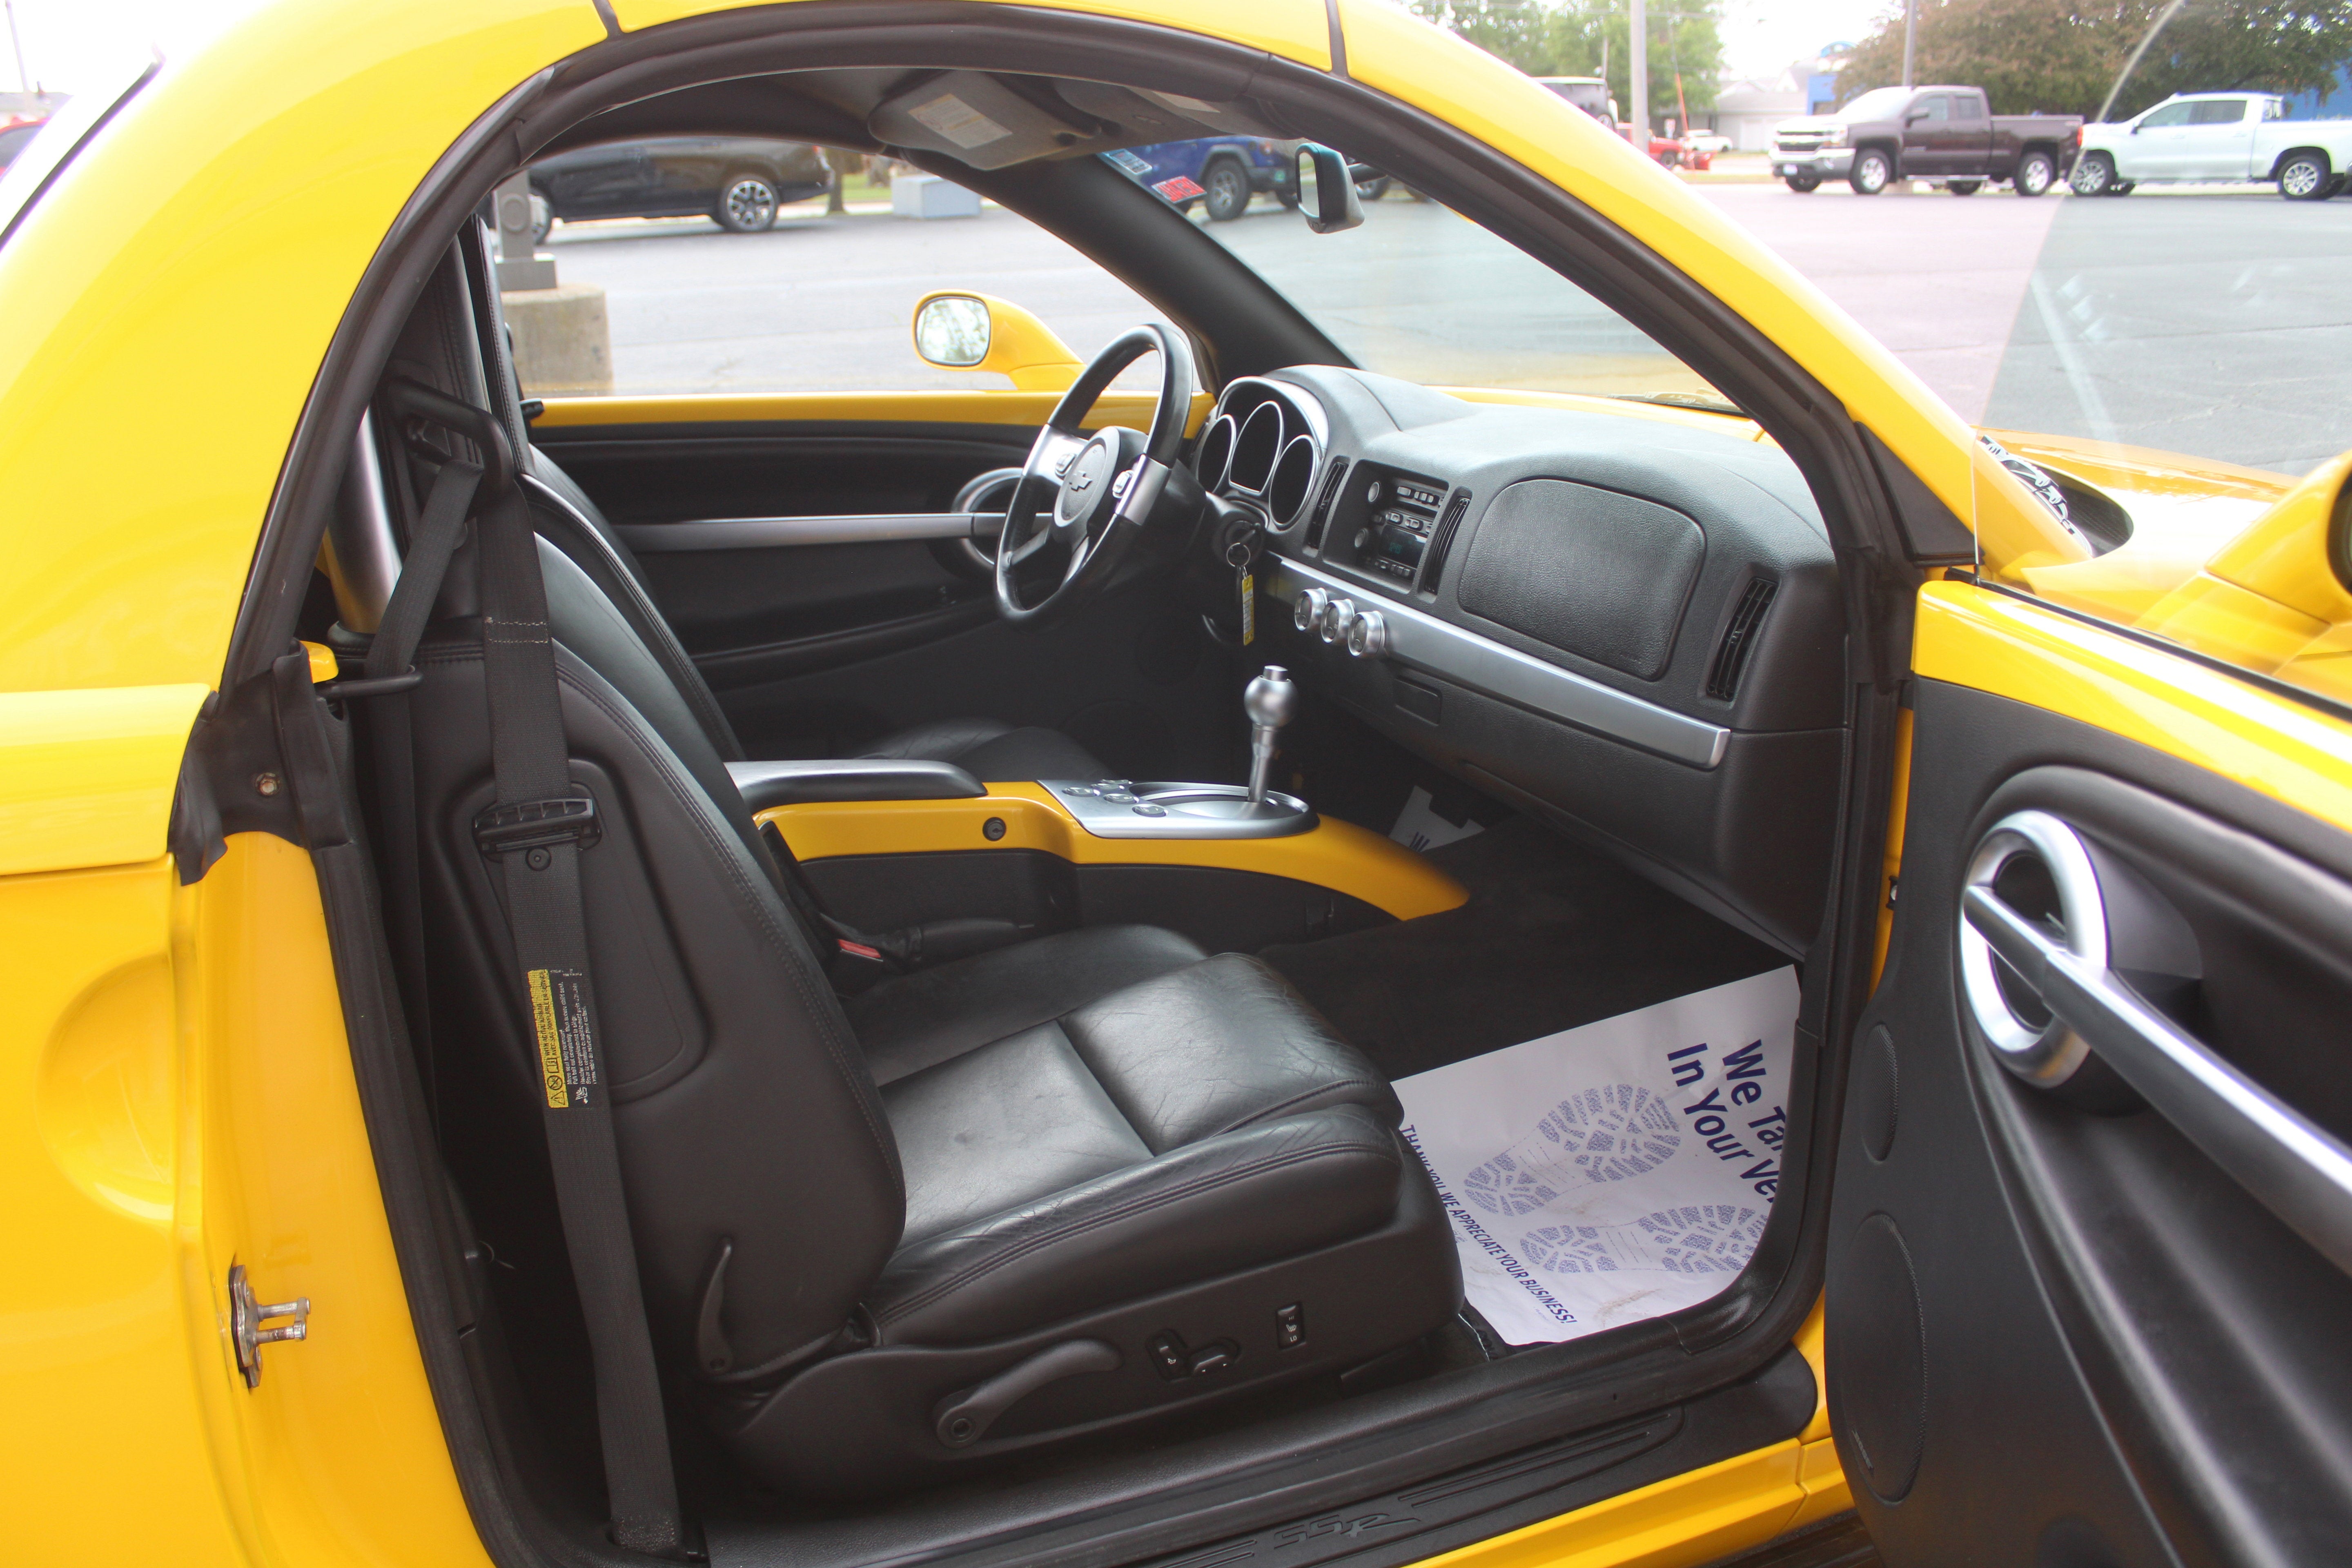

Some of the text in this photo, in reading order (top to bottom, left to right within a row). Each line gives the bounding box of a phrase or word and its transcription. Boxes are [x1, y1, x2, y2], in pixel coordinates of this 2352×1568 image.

[1409, 831, 1430, 853] W
[1722, 1039, 1786, 1156] We Ta
[1667, 1043, 1780, 1203] In Your Ve
[1440, 1192, 1460, 1207] WE
[1448, 1209, 1506, 1255] APPRECIATE
[1496, 1254, 1530, 1278] YOUR
[1519, 1279, 1578, 1324] BUSINESS!
[1274, 1513, 1421, 1550] SSR
